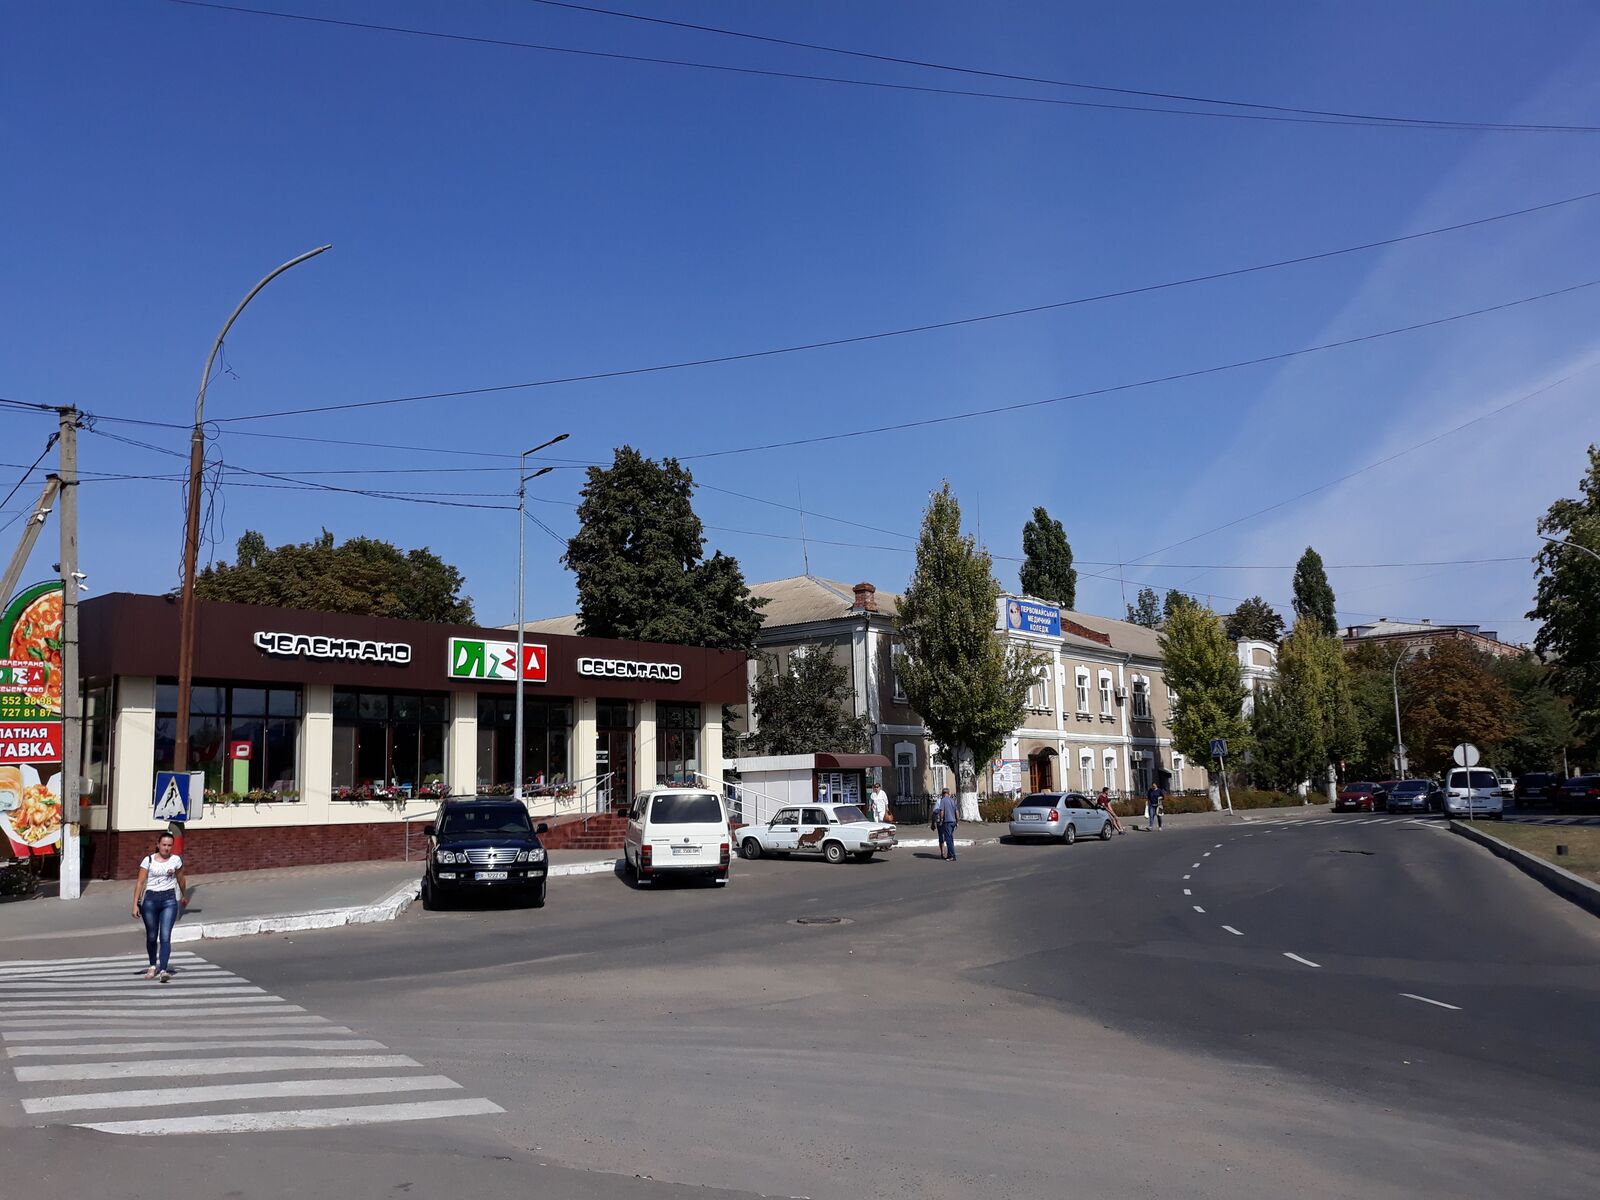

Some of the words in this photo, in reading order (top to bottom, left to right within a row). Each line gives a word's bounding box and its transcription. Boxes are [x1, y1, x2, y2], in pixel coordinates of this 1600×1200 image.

[254, 632, 411, 663] ЧЕЛЕНТАНО
[578, 658, 682, 681] CELENTANO
[2, 696, 21, 705] 552
[24, 696, 37, 705] 98
[39, 696, 52, 705] 98
[2, 708, 21, 717] 727
[24, 708, 36, 717] 81
[39, 708, 52, 717] 87
